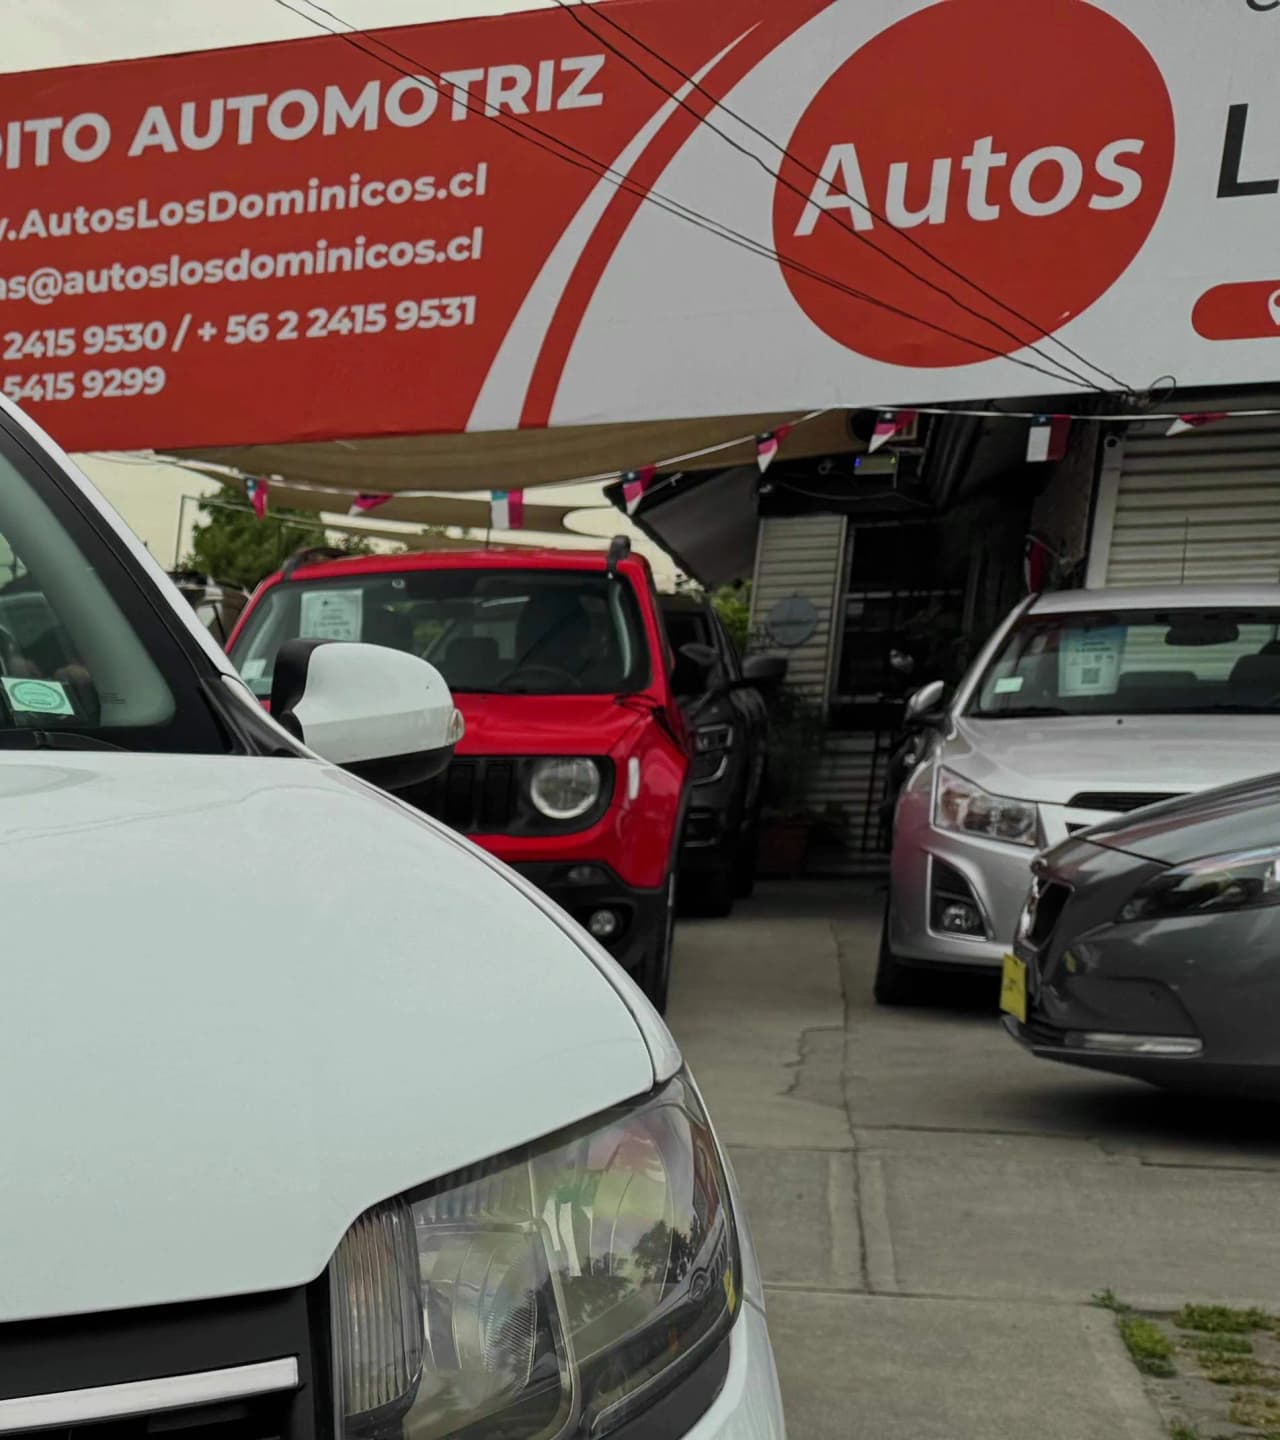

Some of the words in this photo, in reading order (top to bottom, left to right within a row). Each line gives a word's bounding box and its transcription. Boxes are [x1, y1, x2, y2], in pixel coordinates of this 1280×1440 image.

[129, 54, 608, 157] AUTOMOTRIZ
[794, 136, 1145, 237] Autos
[3, 327, 76, 361] 2415
[82, 320, 167, 355] 9530
[172, 313, 192, 352] /
[196, 321, 217, 342] +
[224, 312, 270, 345] 56
[276, 310, 299, 341] 2
[305, 303, 387, 338] 2415
[395, 295, 477, 330] 9531
[2, 371, 75, 403] 5415
[82, 365, 166, 400] 9299
